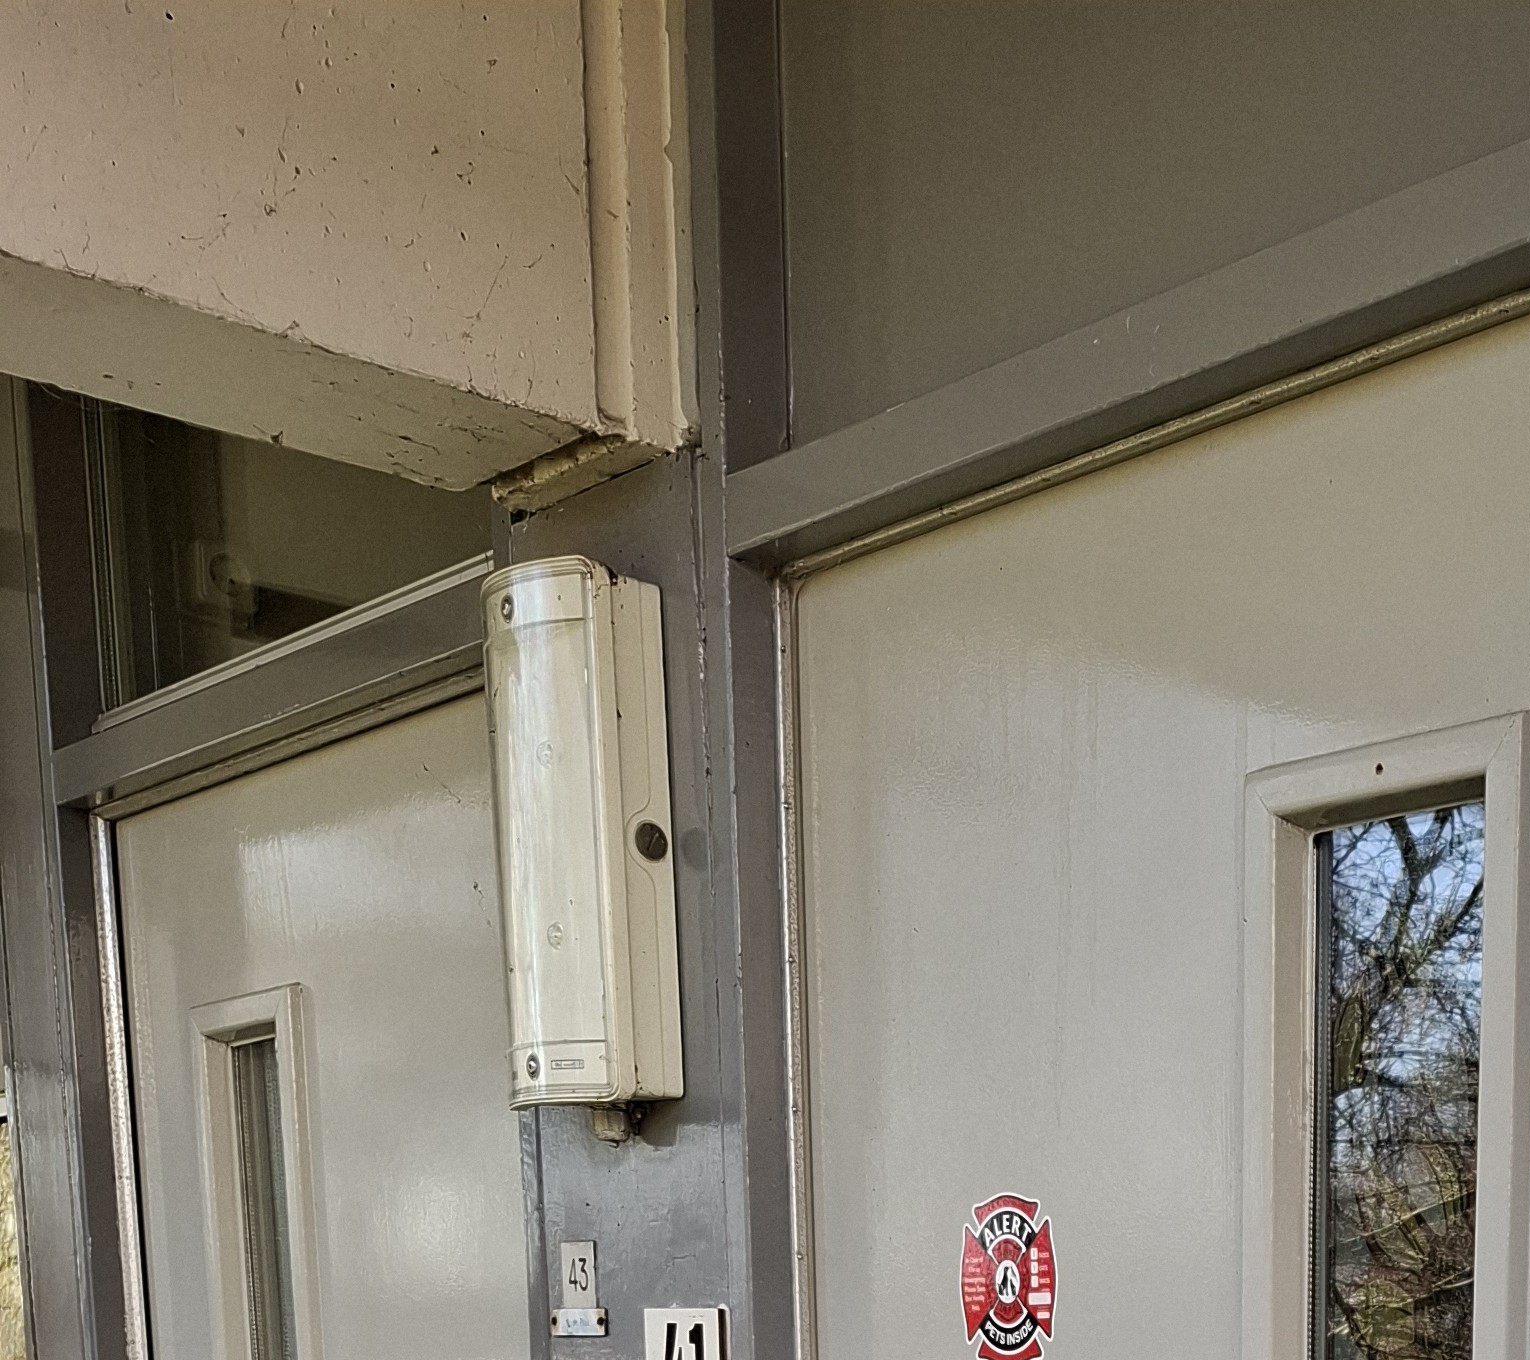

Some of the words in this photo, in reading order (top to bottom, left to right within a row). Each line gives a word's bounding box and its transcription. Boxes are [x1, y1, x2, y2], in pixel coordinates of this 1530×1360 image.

[984, 1214, 1032, 1247] ALERT
[568, 1257, 589, 1292] 43
[984, 1320, 1006, 1345] PETS
[1006, 1318, 1034, 1346] INSIDE
